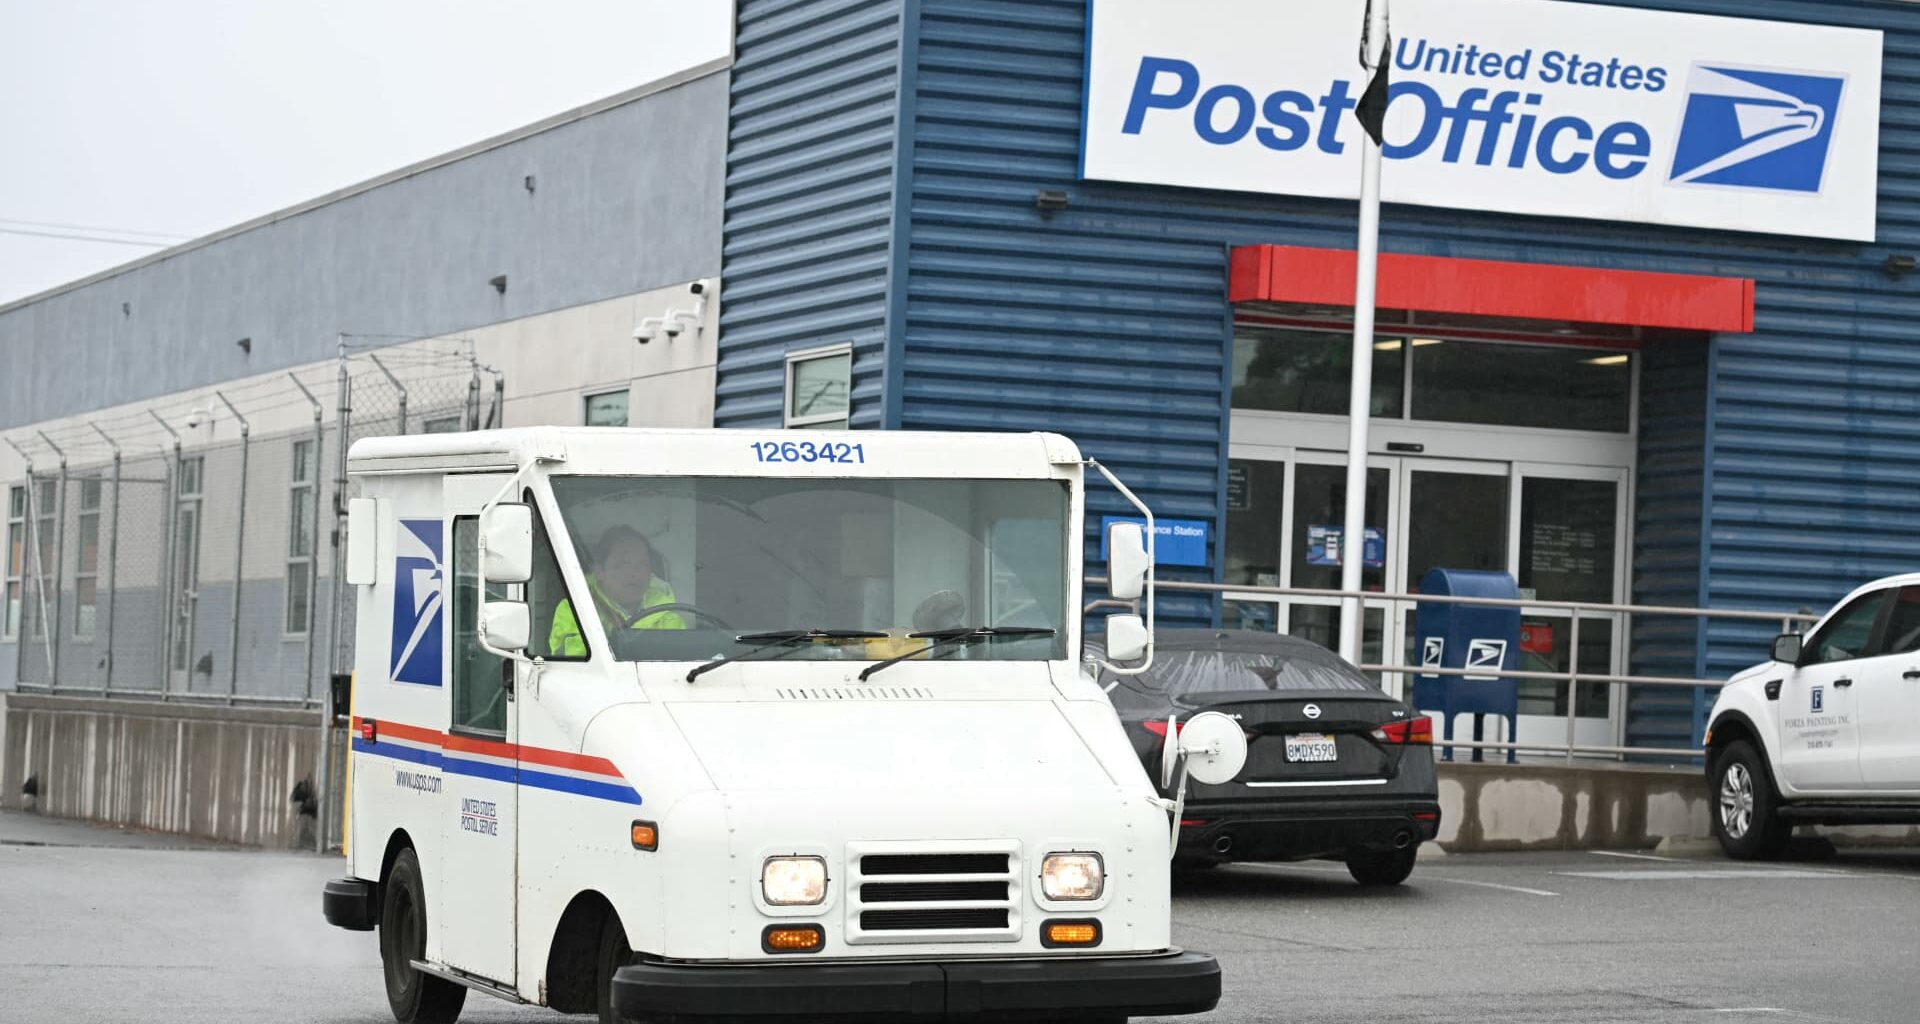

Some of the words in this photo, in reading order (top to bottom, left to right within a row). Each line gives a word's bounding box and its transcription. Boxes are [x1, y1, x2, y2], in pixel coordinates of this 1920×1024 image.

[1395, 37, 1532, 80] United
[1538, 50, 1667, 92] States
[1121, 55, 1357, 155] Post
[1381, 80, 1651, 180] Office
[750, 441, 865, 464] 1263421
[1173, 525, 1204, 537] Station
[1806, 716, 1837, 727] PAINTING
[1287, 743, 1335, 758] 8MDX590
[396, 770, 442, 795] www.usps.com
[462, 798, 480, 814] UNITED
[480, 800, 497, 817] STATES
[461, 815, 479, 833] POSTAL
[479, 818, 498, 836] SERVICE
